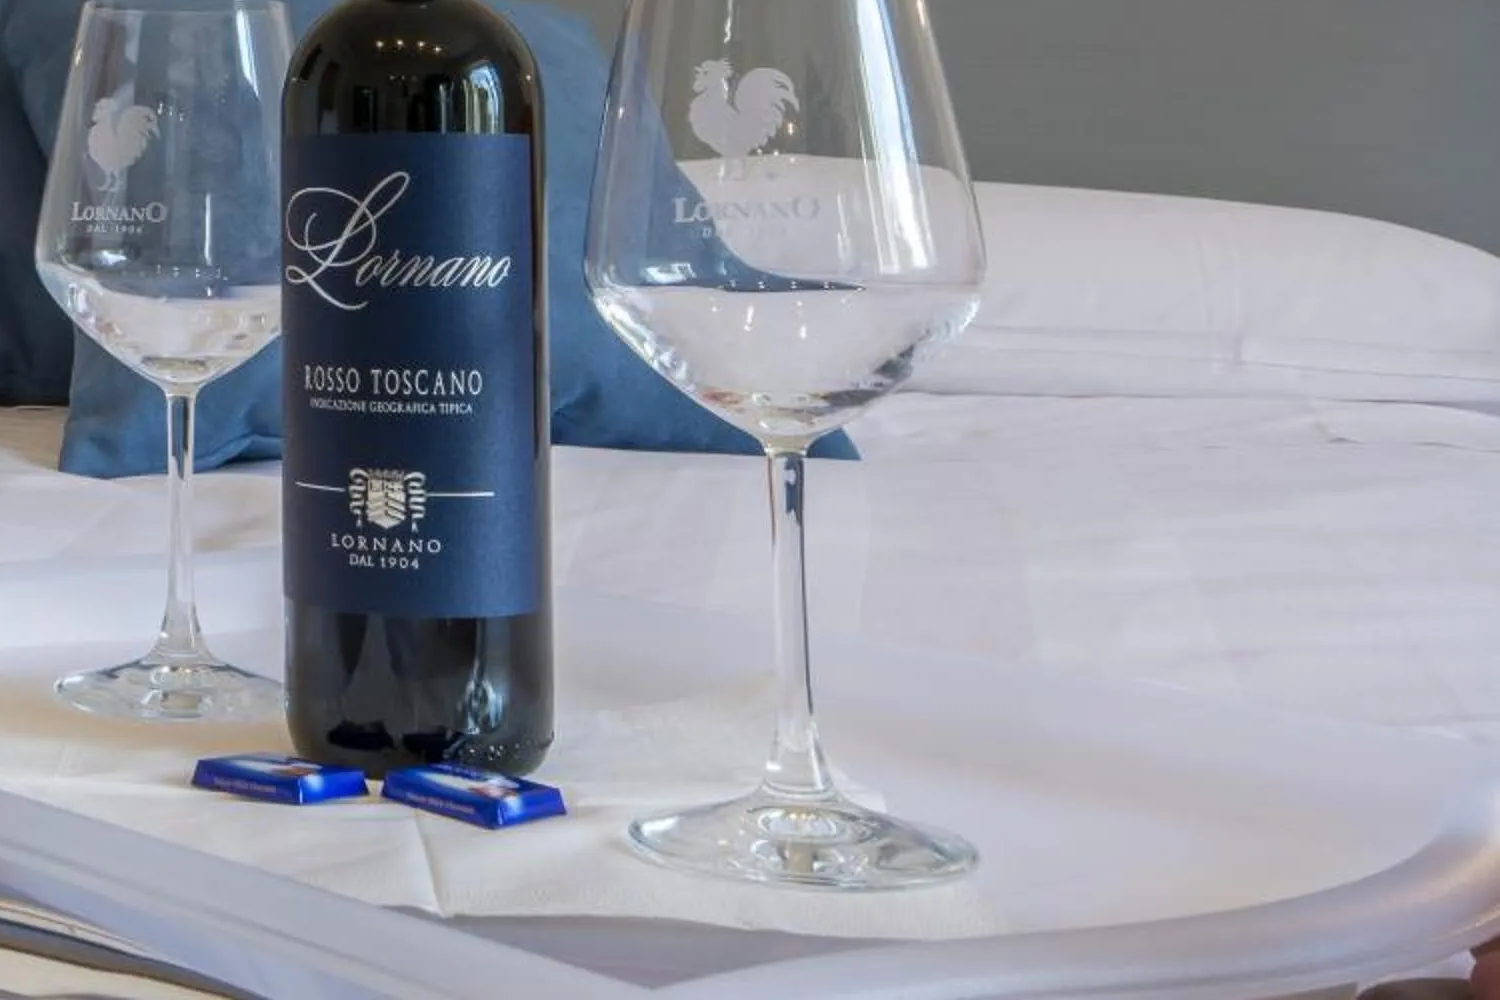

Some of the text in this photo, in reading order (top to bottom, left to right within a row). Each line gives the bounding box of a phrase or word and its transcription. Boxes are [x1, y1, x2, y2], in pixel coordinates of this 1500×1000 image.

[71, 201, 168, 223] LORNANO
[286, 171, 511, 310] Lornano
[304, 365, 483, 396] ROSSO TOSCANO
[369, 400, 436, 414] GEOGRAFICA
[437, 403, 473, 415] TIPICA
[330, 532, 441, 553] LORNANO
[349, 553, 419, 570] DAL 1904
